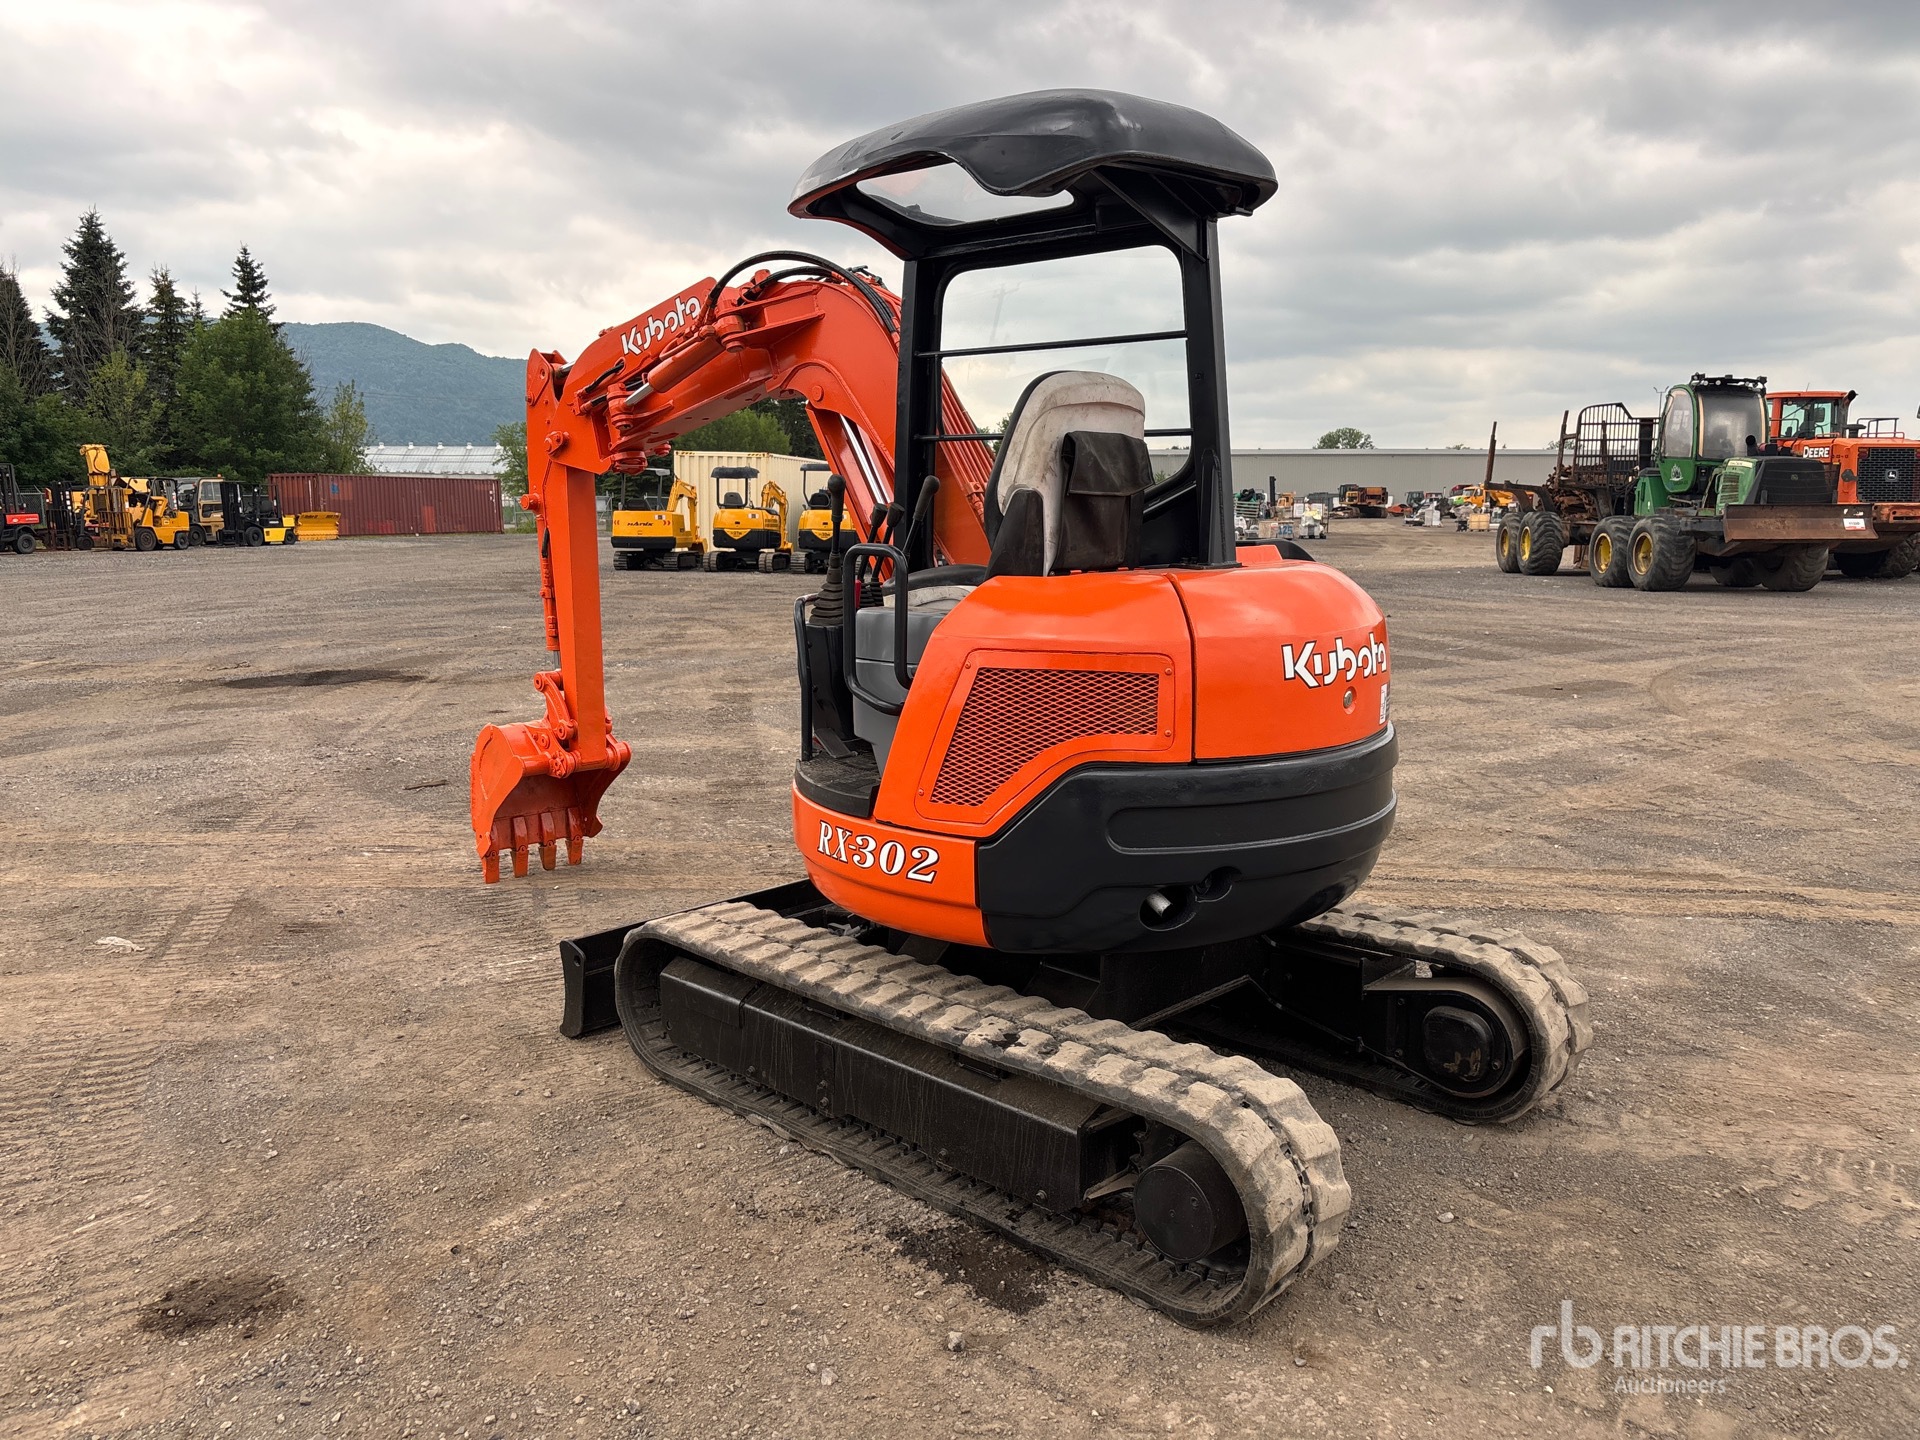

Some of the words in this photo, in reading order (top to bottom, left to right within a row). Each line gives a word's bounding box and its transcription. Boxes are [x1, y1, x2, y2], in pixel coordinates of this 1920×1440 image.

[620, 295, 702, 355] Kubota
[1803, 446, 1830, 458] DEERE
[1281, 632, 1388, 689] Kubota
[817, 819, 940, 884] RX-302
